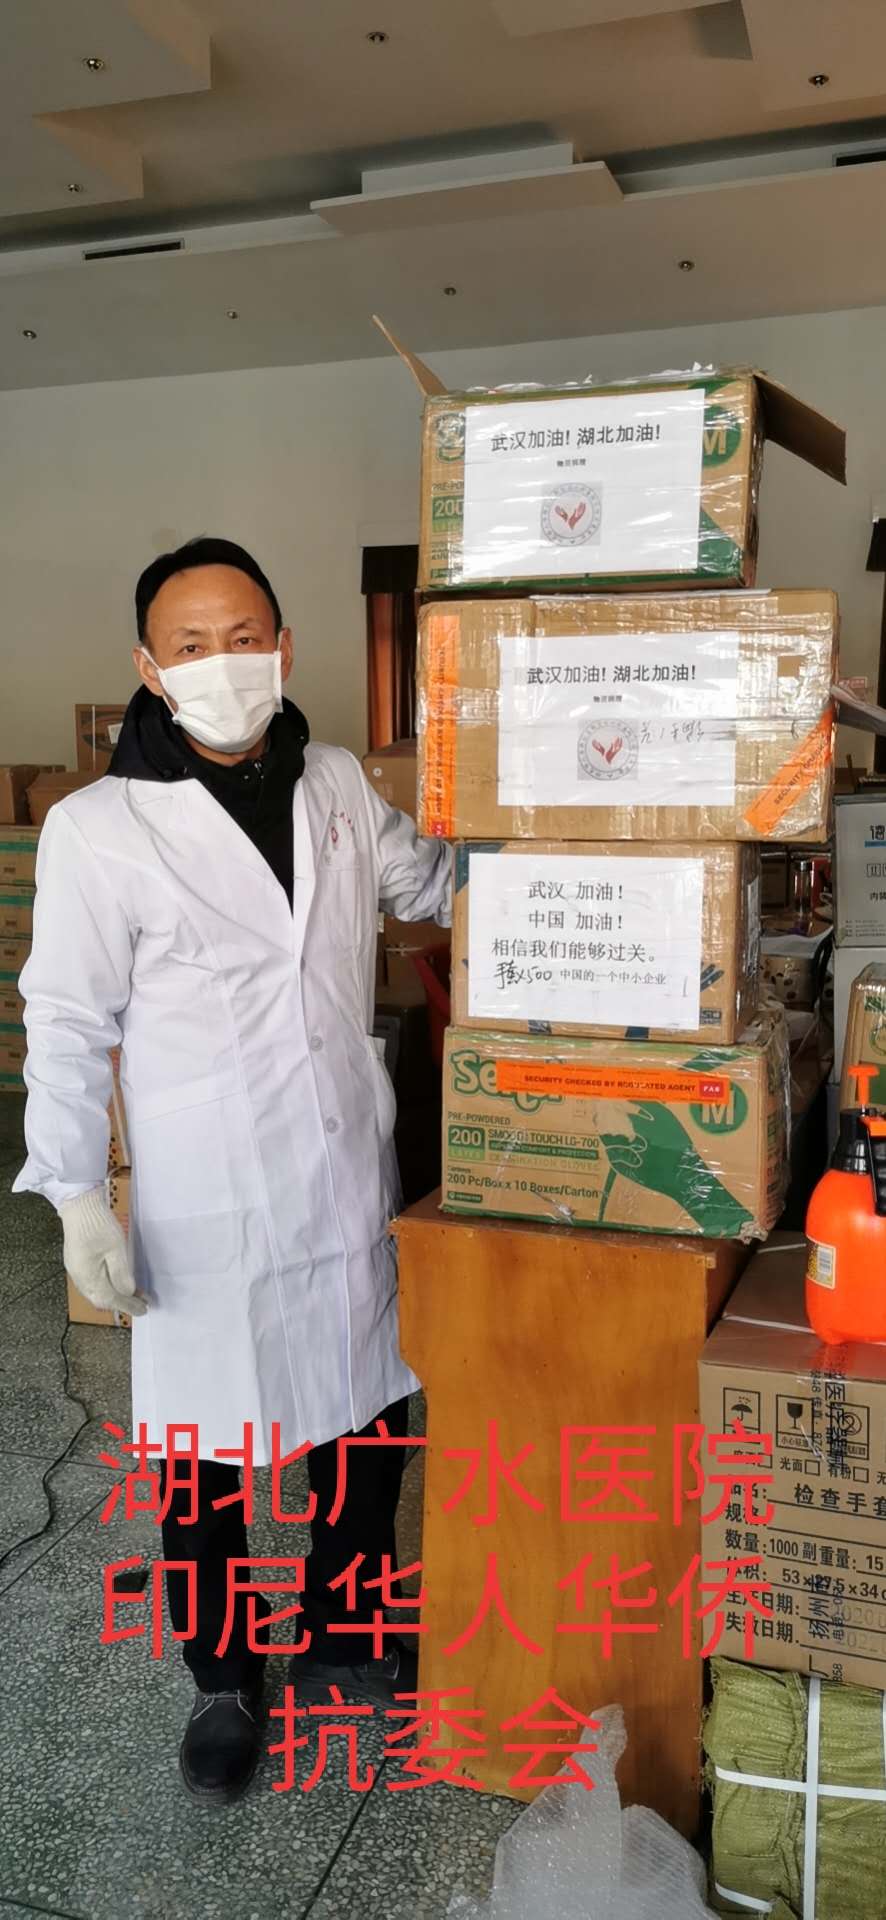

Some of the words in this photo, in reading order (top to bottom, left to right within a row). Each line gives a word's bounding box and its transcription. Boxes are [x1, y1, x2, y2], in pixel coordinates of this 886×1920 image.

[491, 429, 570, 451] 武汉加油!
[576, 423, 661, 447] 湖北加油!
[527, 665, 606, 684] 武汉加油!
[612, 664, 696, 683] 湖北加油!
[528, 880, 566, 900] 武汉
[575, 881, 623, 901] 加油！
[528, 910, 565, 929] 中国
[575, 912, 623, 931] 加油！
[491, 938, 655, 962] 相信我们能够过关。
[560, 969, 666, 985] 中国的一个中小企业
[524, 1075, 562, 1085] SECURITY
[565, 1078, 601, 1087] CHECKED
[604, 1080, 615, 1088] BY
[668, 1083, 696, 1092] AGENT
[448, 1111, 511, 1126] PRE-POWDERED
[450, 1128, 482, 1146] 200
[530, 1133, 563, 1145] TOUCH
[565, 1136, 600, 1148] LG-700
[448, 1173, 466, 1185] 200
[515, 1181, 527, 1191] 10
[530, 1182, 599, 1198] Boxes/Carton
[780, 1457, 803, 1473] 光面
